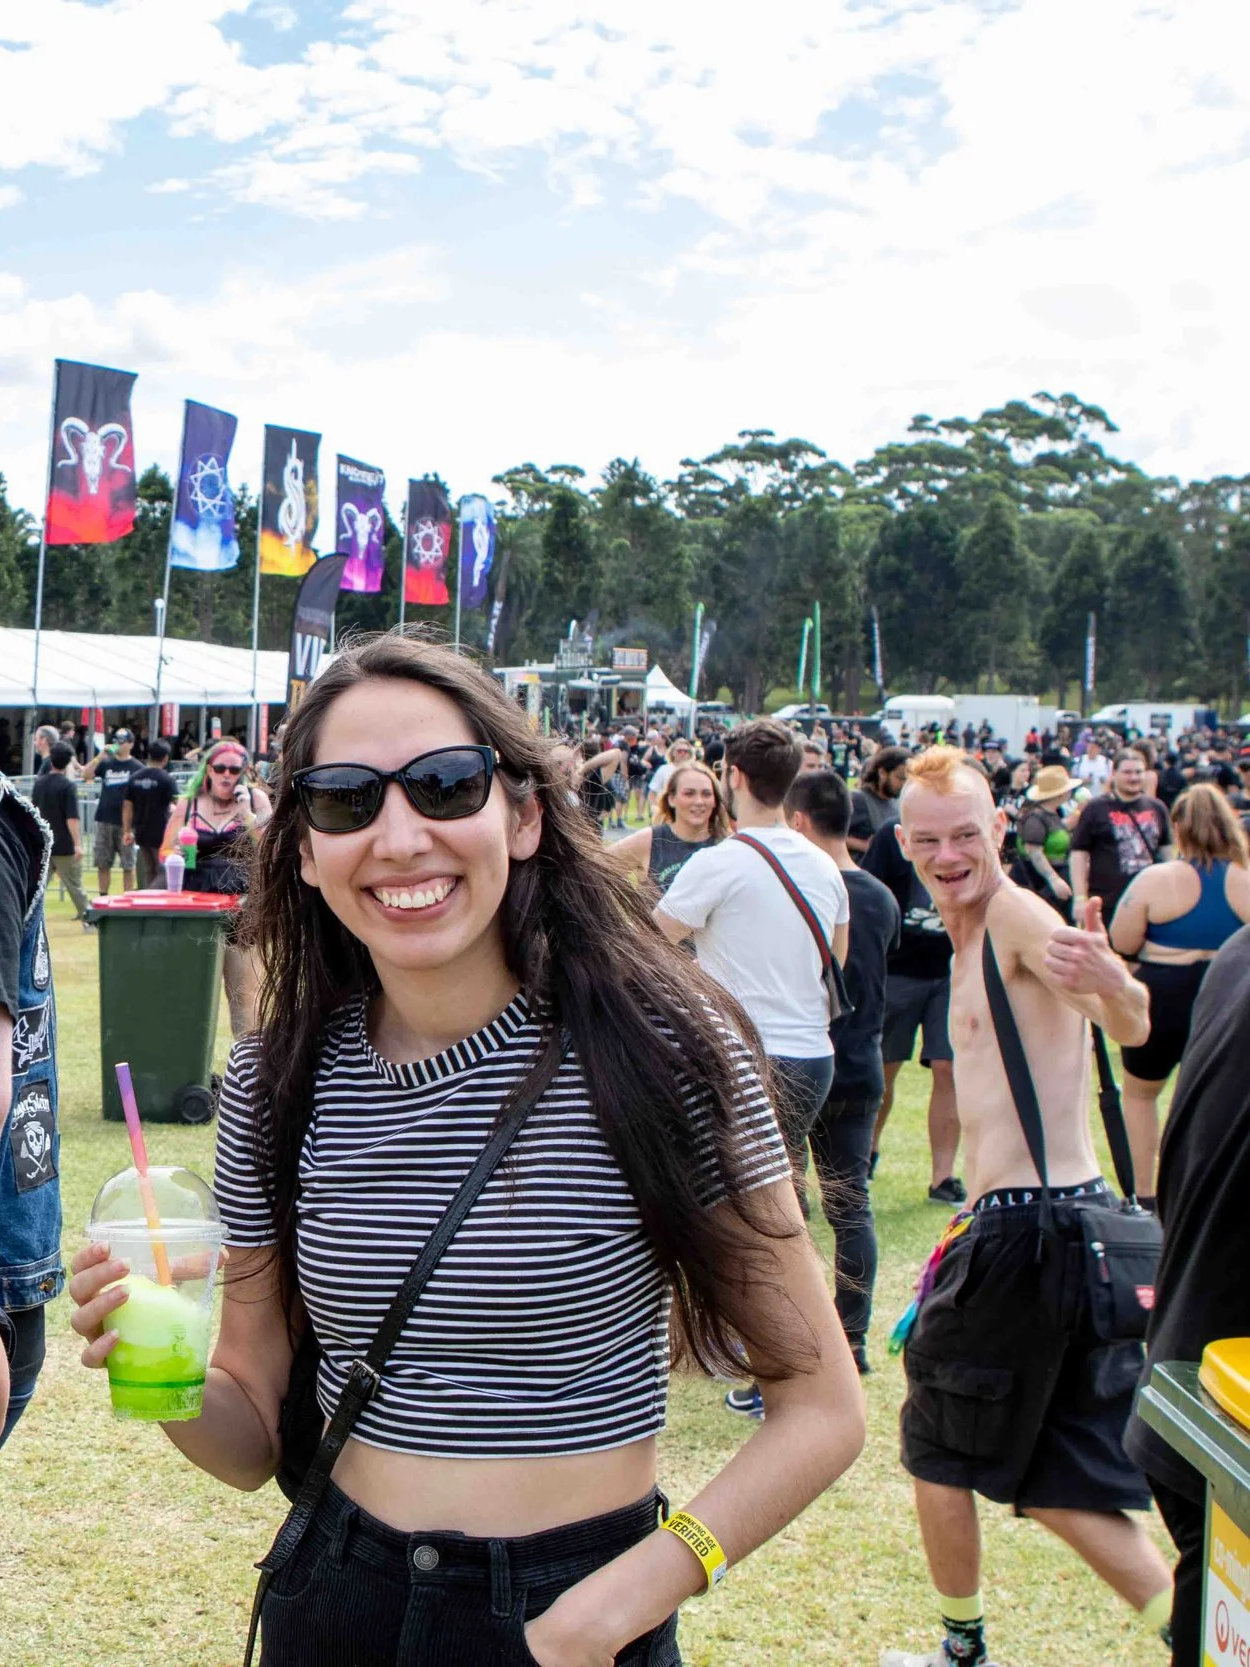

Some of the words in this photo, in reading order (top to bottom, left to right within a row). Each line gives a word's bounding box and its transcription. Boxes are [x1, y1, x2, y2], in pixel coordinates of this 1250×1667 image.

[668, 1519, 710, 1557] VERIFIED
[675, 1513, 706, 1538] DRINKING
[703, 1535, 717, 1551] AGE
